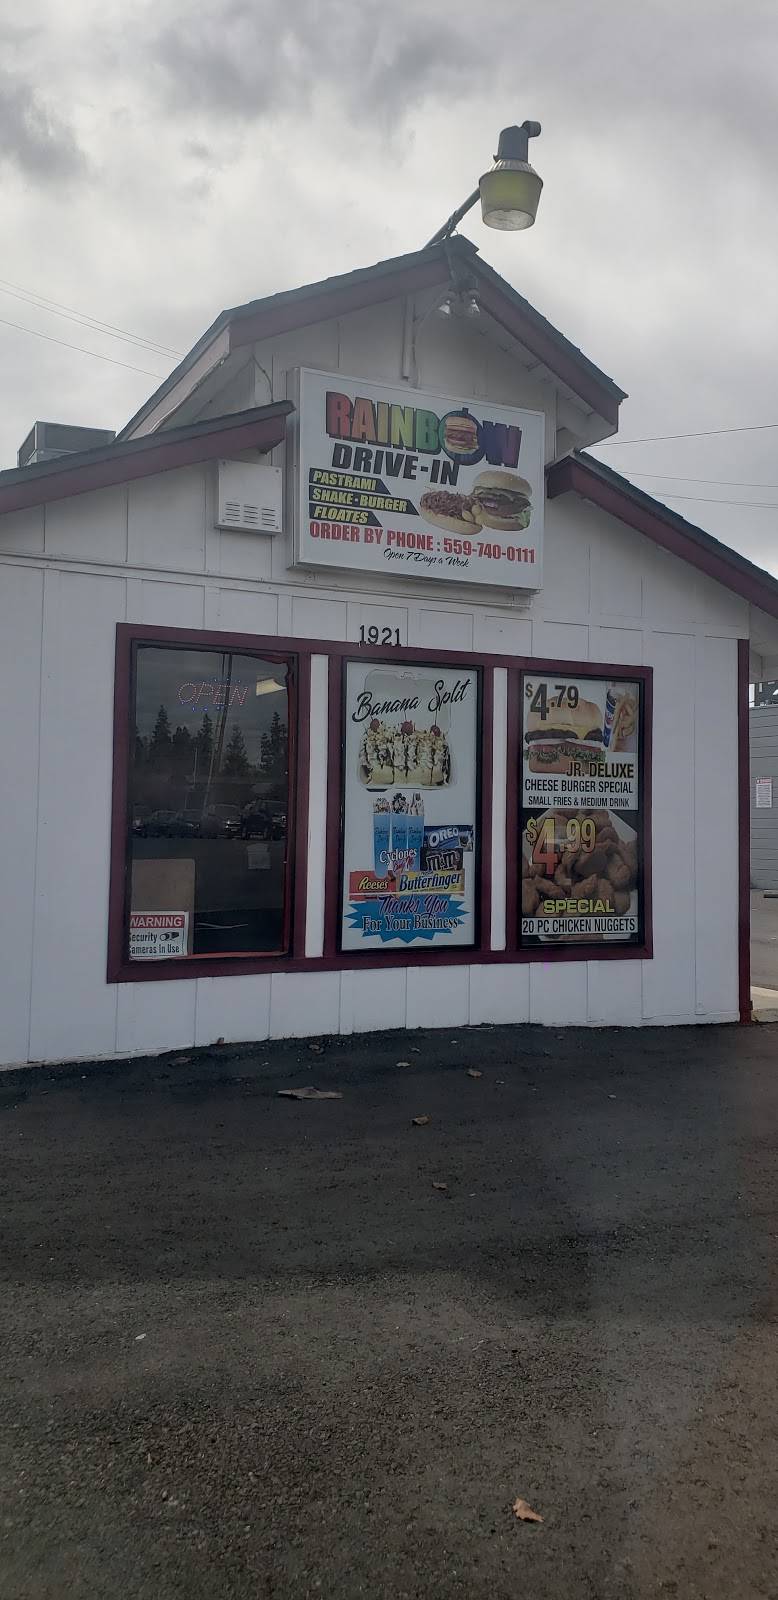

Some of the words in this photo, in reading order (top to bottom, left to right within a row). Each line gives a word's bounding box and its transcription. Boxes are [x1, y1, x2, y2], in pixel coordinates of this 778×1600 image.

[325, 391, 522, 469] RAINBOW
[331, 442, 459, 486] DRIVE-IN
[312, 470, 376, 491] PASTRAMI
[313, 506, 369, 524] FLOATES
[309, 521, 360, 543] ORDER
[364, 527, 383, 545] BY
[386, 530, 433, 551] PHONE
[443, 537, 535, 563] 559-740-0111
[383, 548, 405, 561] Open
[414, 552, 437, 566] Days
[445, 556, 470, 568] Week
[359, 625, 401, 647] 1921
[178, 681, 248, 706] OPEN
[352, 691, 421, 722] Banana
[428, 679, 472, 712] Split
[524, 683, 579, 720] $4.79
[566, 762, 585, 777] JR.
[589, 762, 634, 778] DELUXE
[524, 778, 559, 791] CHEESE
[561, 780, 596, 792] BURGER
[598, 781, 633, 793] SPECIAL
[528, 795, 553, 806] SMALL
[553, 796, 572, 806] FRIES
[573, 797, 579, 806] &
[580, 797, 607, 807] MEDIUM
[609, 798, 630, 807] DRINK
[428, 827, 459, 848] OREO
[379, 847, 417, 865] Cyclones
[399, 872, 461, 891] Butterfinger
[378, 894, 420, 915] Thanks
[421, 894, 449, 918] You
[543, 899, 615, 914] SPECIAL
[362, 915, 381, 931] For
[384, 915, 410, 931] Your
[413, 914, 459, 930] Business
[522, 919, 535, 933] 20
[537, 919, 550, 932] PC
[552, 919, 591, 932] CHICKEN
[594, 918, 635, 931] NUGGETS
[130, 932, 158, 943] ecurity
[130, 945, 157, 954] ameras
[167, 943, 180, 953] Use
